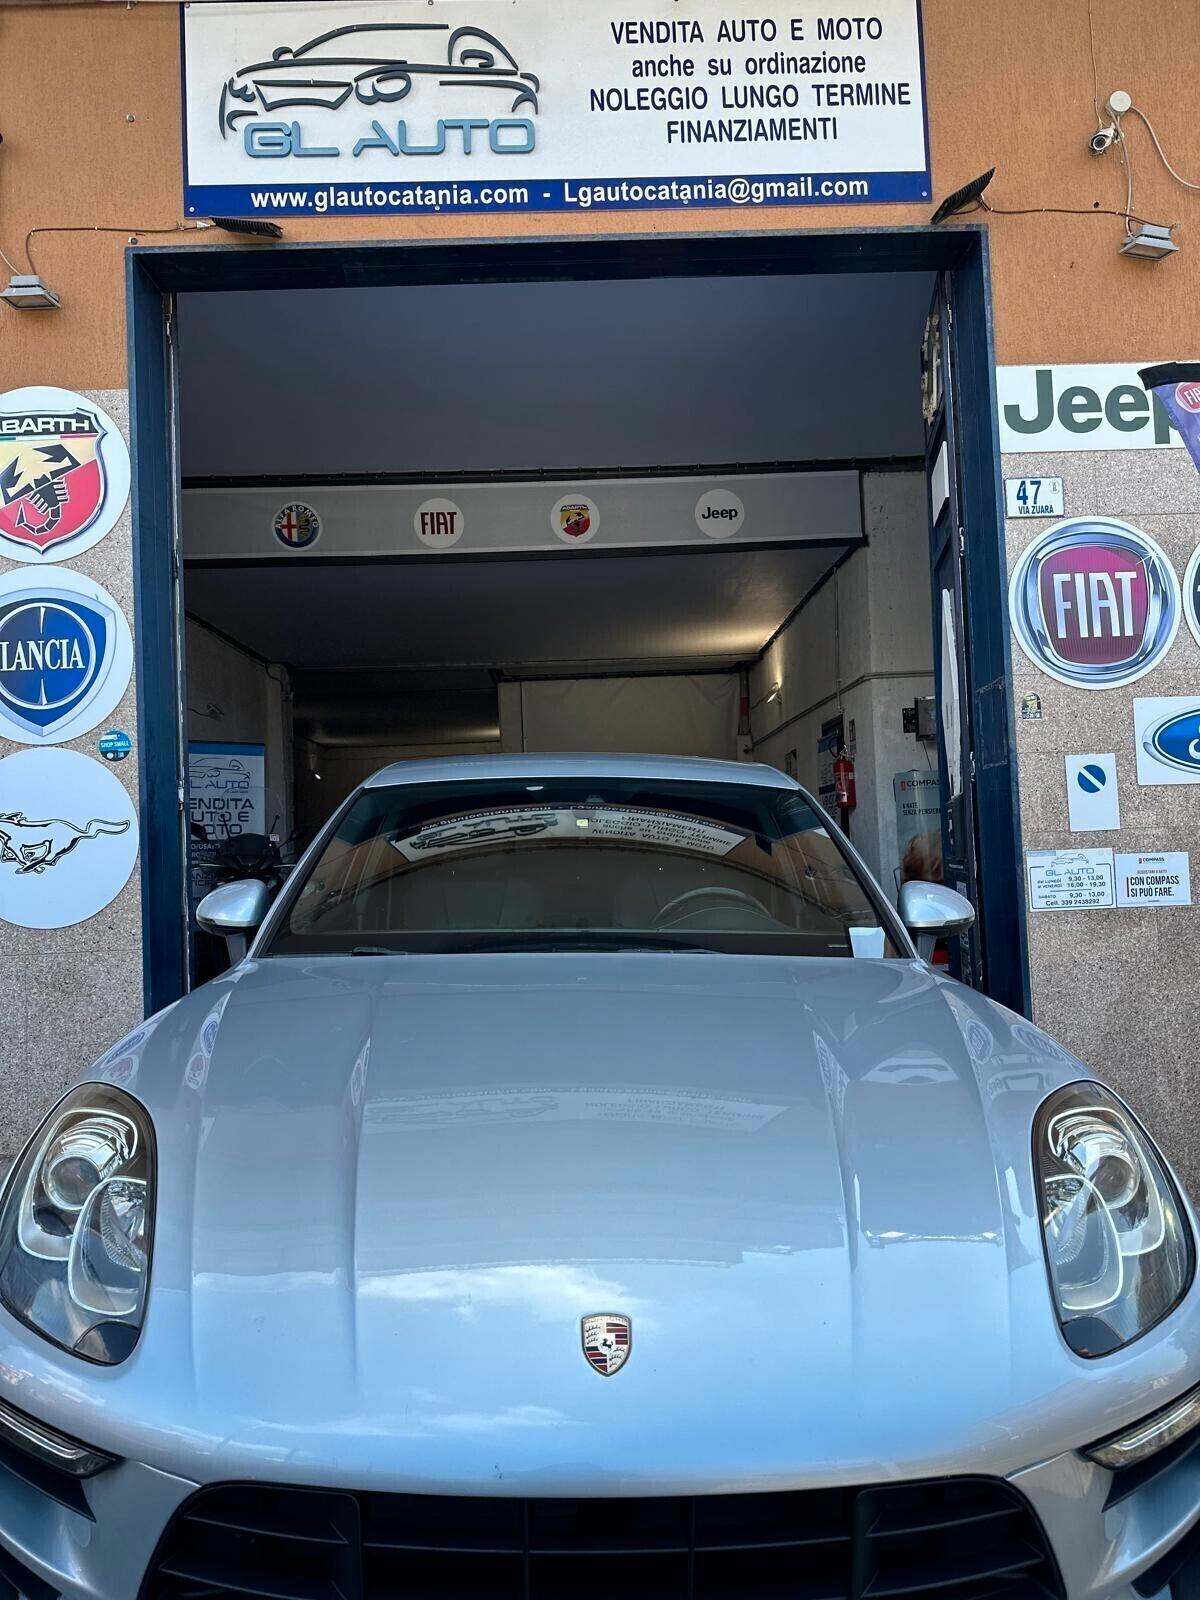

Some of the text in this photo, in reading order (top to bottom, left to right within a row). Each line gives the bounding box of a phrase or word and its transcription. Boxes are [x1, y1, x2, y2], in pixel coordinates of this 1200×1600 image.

[611, 17, 883, 44] VENDITA AUTO E MOTO
[632, 51, 866, 77] anche su ordinazione
[590, 83, 911, 112] NOLEGGIO LUNGO TERMINE
[244, 119, 535, 157] GL AUTO
[666, 117, 838, 144] FINANZIAMENTI
[251, 186, 529, 211] www.glautocatania.com
[564, 176, 869, 207] Lgautocatania@gmail.com
[1183, 386, 1200, 405] FIA
[0, 417, 90, 433] BARTH
[1016, 480, 1042, 505] 47
[292, 505, 319, 528] ROMEO
[701, 506, 738, 520] Jeep
[1018, 504, 1054, 514] VIA ZUARA
[420, 511, 457, 535] FIAT
[1052, 571, 1137, 639] FIAT
[0, 638, 86, 671] LANCIA
[205, 780, 250, 789] AUTO
[189, 798, 254, 810] ENDITA
[191, 811, 249, 822] UTO E
[203, 824, 242, 835] OTO
[1130, 876, 1179, 886] CON COMPASS
[1131, 886, 1174, 897] SI PUÒ FARE.
